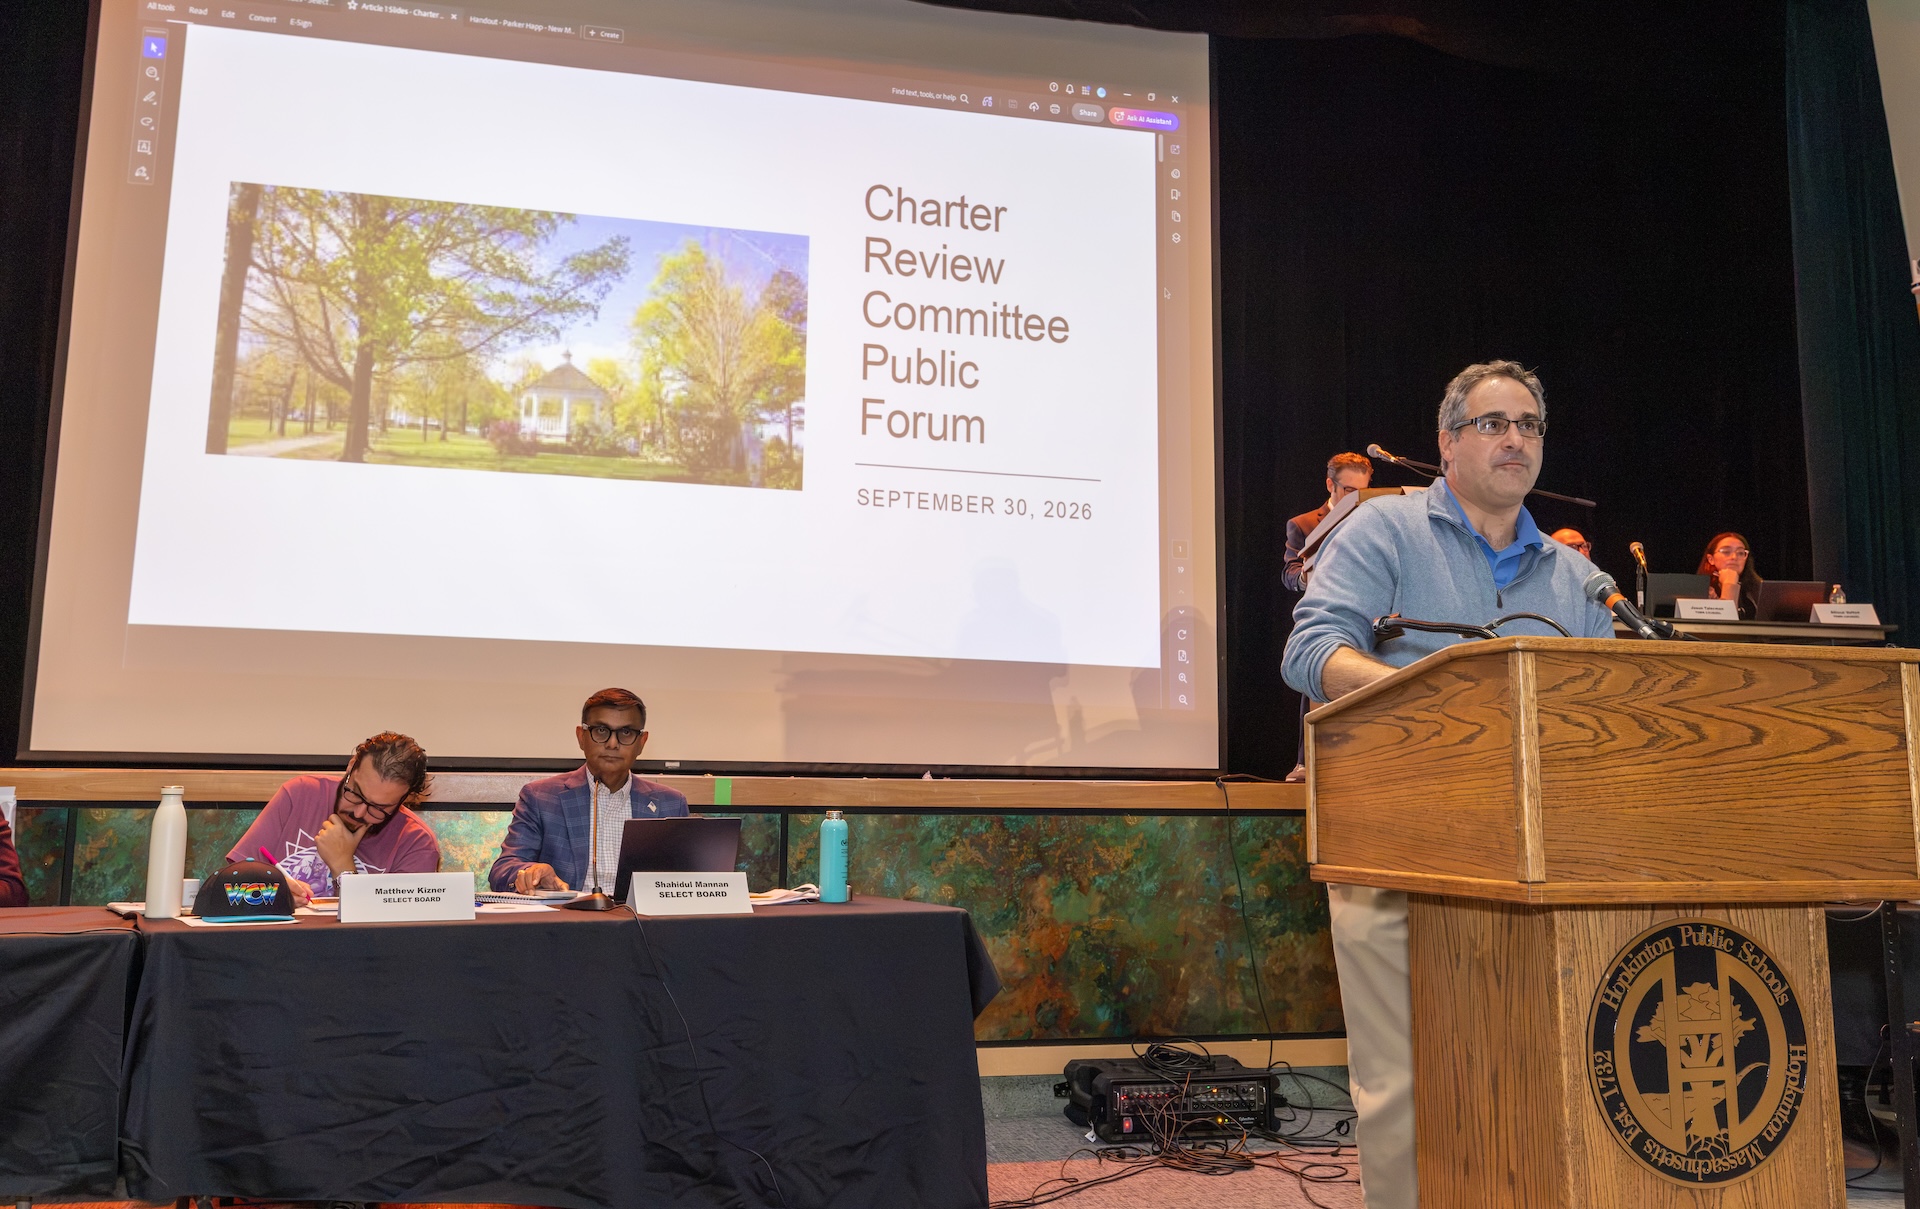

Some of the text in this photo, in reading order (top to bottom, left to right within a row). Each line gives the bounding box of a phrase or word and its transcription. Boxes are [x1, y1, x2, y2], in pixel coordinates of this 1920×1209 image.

[147, 2, 176, 12] All tools
[189, 6, 208, 16] Read
[221, 10, 235, 19] Edit
[361, 3, 384, 13] Article
[388, 6, 409, 16] Slides
[413, 9, 440, 19] Charter
[249, 13, 277, 24] Convert
[290, 17, 313, 29] E-Sign
[470, 15, 498, 26] Handout
[503, 19, 525, 29] Parker
[525, 22, 544, 32] Happ
[548, 25, 563, 33] New
[600, 31, 620, 40] Create
[892, 87, 905, 96] Find
[906, 89, 919, 97] text,
[919, 91, 935, 99] tools,
[942, 93, 957, 102] help
[1079, 108, 1098, 118] Share
[1127, 114, 1138, 122] Ask
[1146, 116, 1173, 126] Assistant
[865, 184, 1008, 233] Charter
[864, 236, 1006, 285] Review
[862, 290, 1070, 344] Committee
[862, 343, 980, 389] Public
[861, 397, 985, 444] Forum
[857, 488, 1093, 520] SEPTEMBER 30, 2026
[375, 886, 447, 895] Matthew Kizner
[1601, 925, 1790, 1012] Hopkinton Public Schools
[1593, 1049, 1643, 1147] Est. 1732
[1643, 1043, 1807, 1182] Hopkinton Massachusetts
